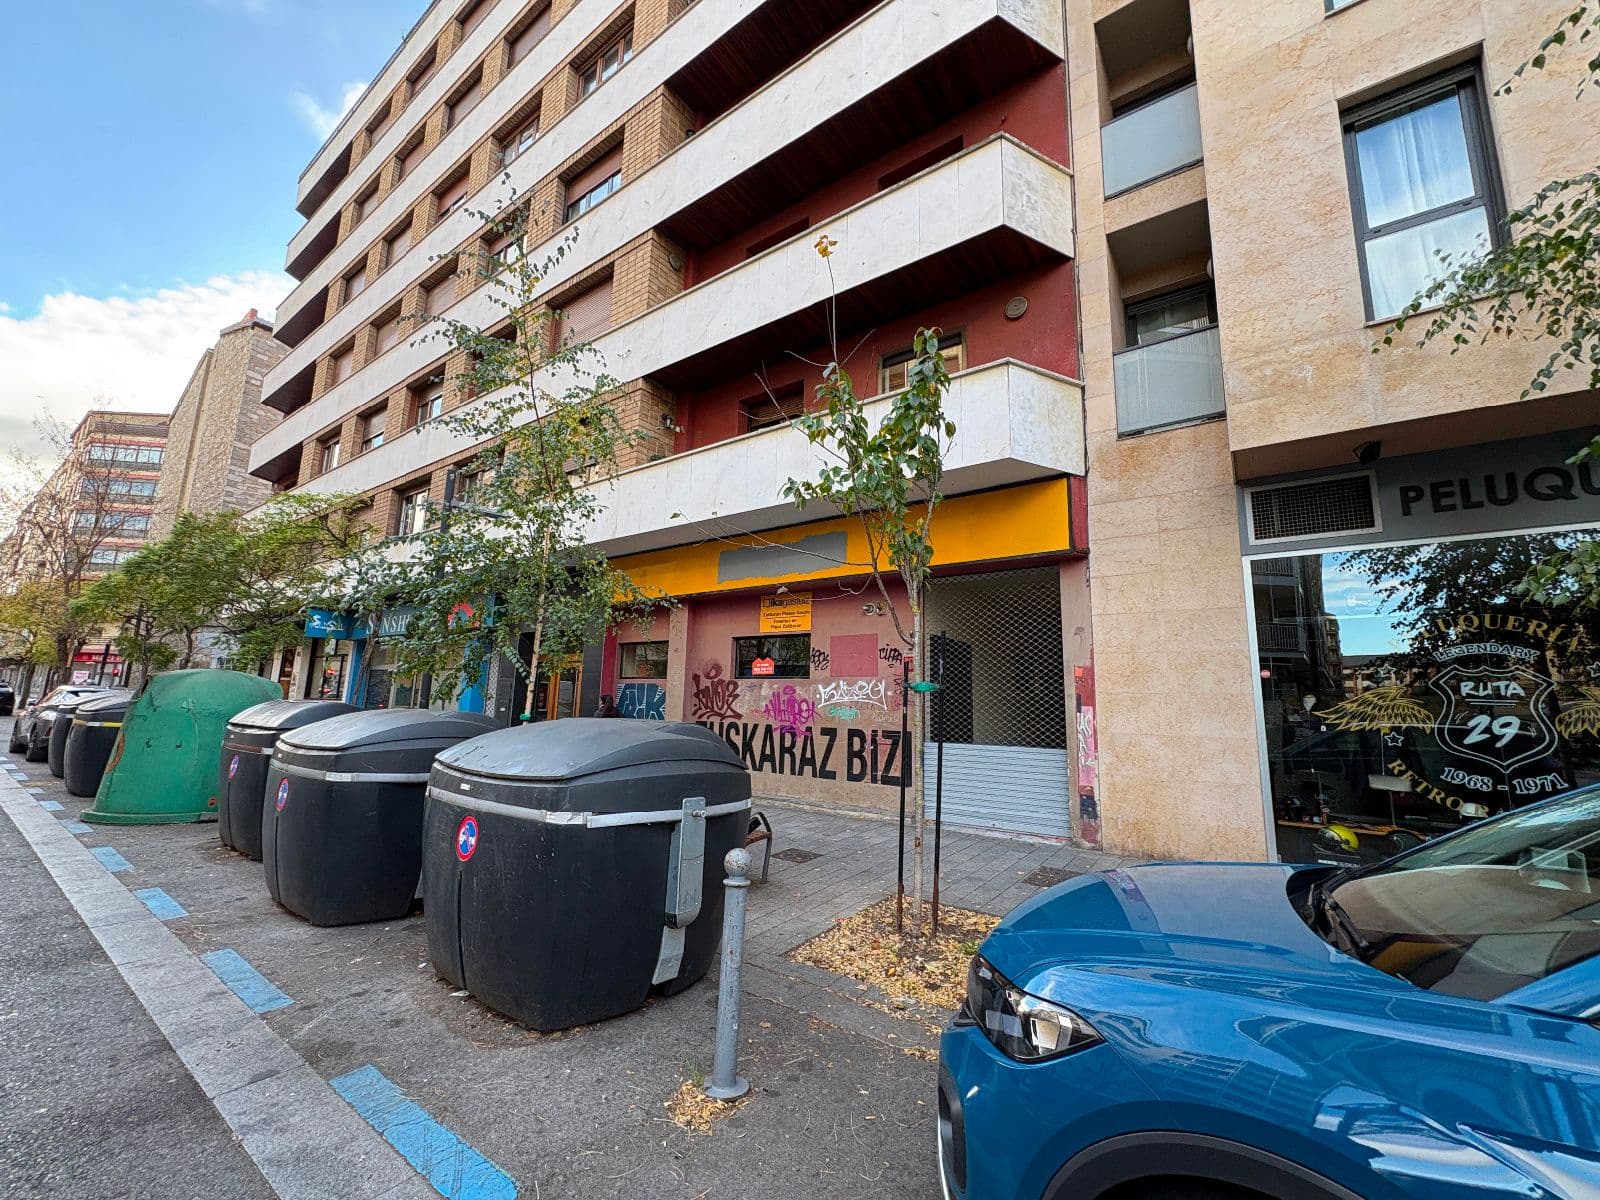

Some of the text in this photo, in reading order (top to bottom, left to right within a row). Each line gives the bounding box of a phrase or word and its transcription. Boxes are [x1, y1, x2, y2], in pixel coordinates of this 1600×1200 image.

[1432, 642, 1541, 663] LEGENDARY
[1459, 679, 1526, 699] RUTA
[1462, 714, 1521, 748] 29
[695, 720, 838, 781] SKARAZ
[1386, 757, 1466, 812] RETRO
[1440, 766, 1494, 792] 1968
[1512, 772, 1569, 795] 1971
